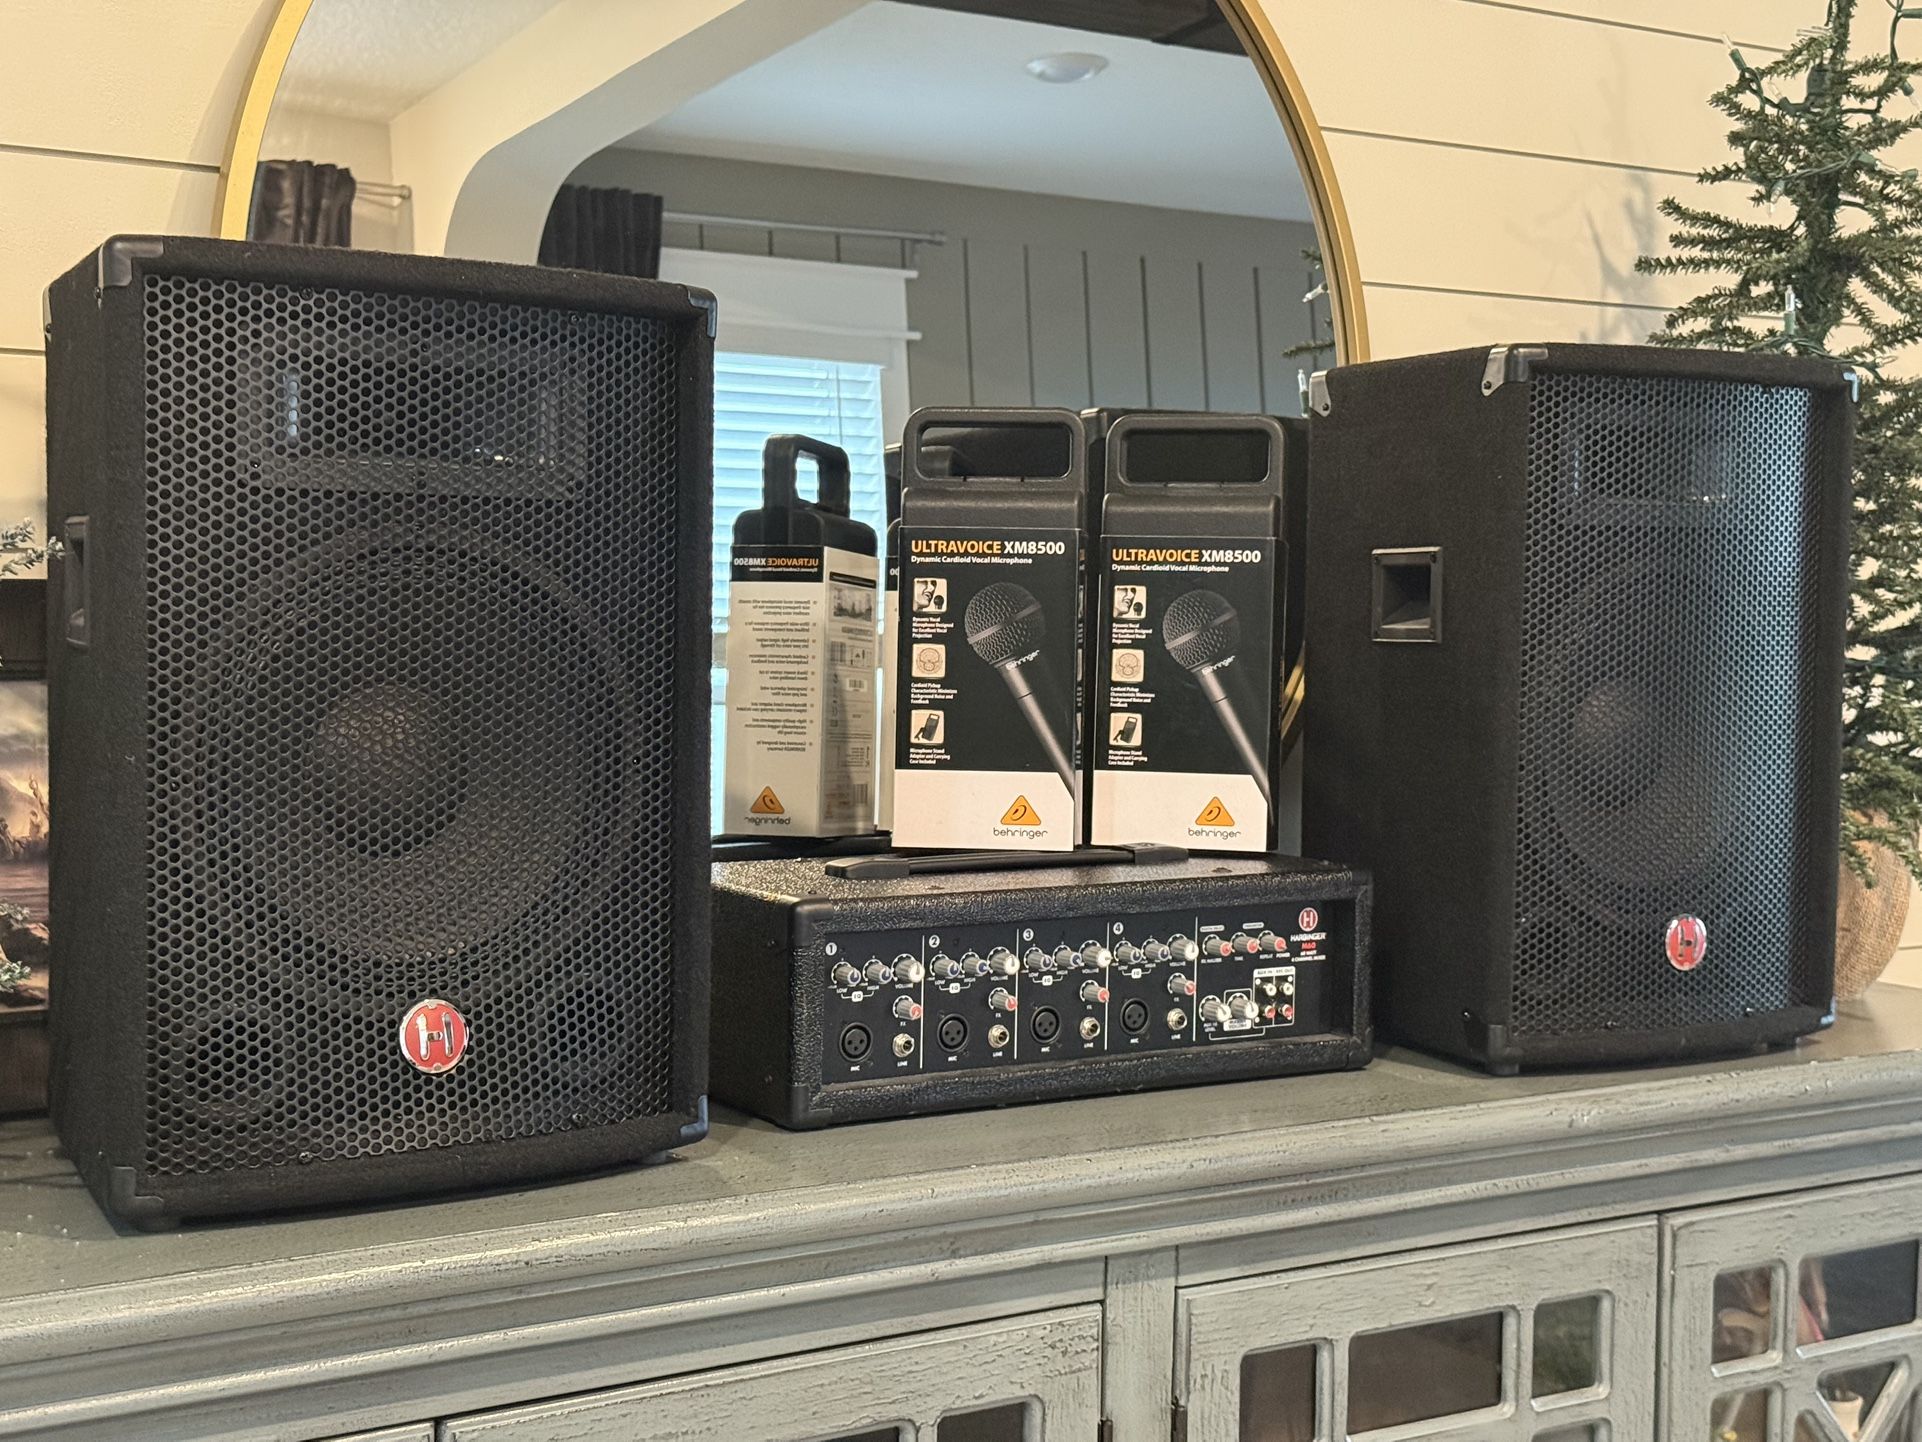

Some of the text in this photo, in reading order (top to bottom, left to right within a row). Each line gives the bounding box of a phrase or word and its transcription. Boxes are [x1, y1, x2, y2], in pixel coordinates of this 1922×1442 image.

[911, 539, 1065, 555] ULTRAVOICE XM8500
[911, 556, 1032, 565] Dynamic Cardioid Vocal Microphone
[1112, 549, 1261, 563] ULTRAVOICE XM8500
[1112, 564, 1140, 572] Dynamic
[1170, 564, 1188, 572] Vocal
[993, 827, 1048, 840] behringer
[1188, 828, 1241, 840] behringer
[1290, 932, 1327, 942] HARBINGER
